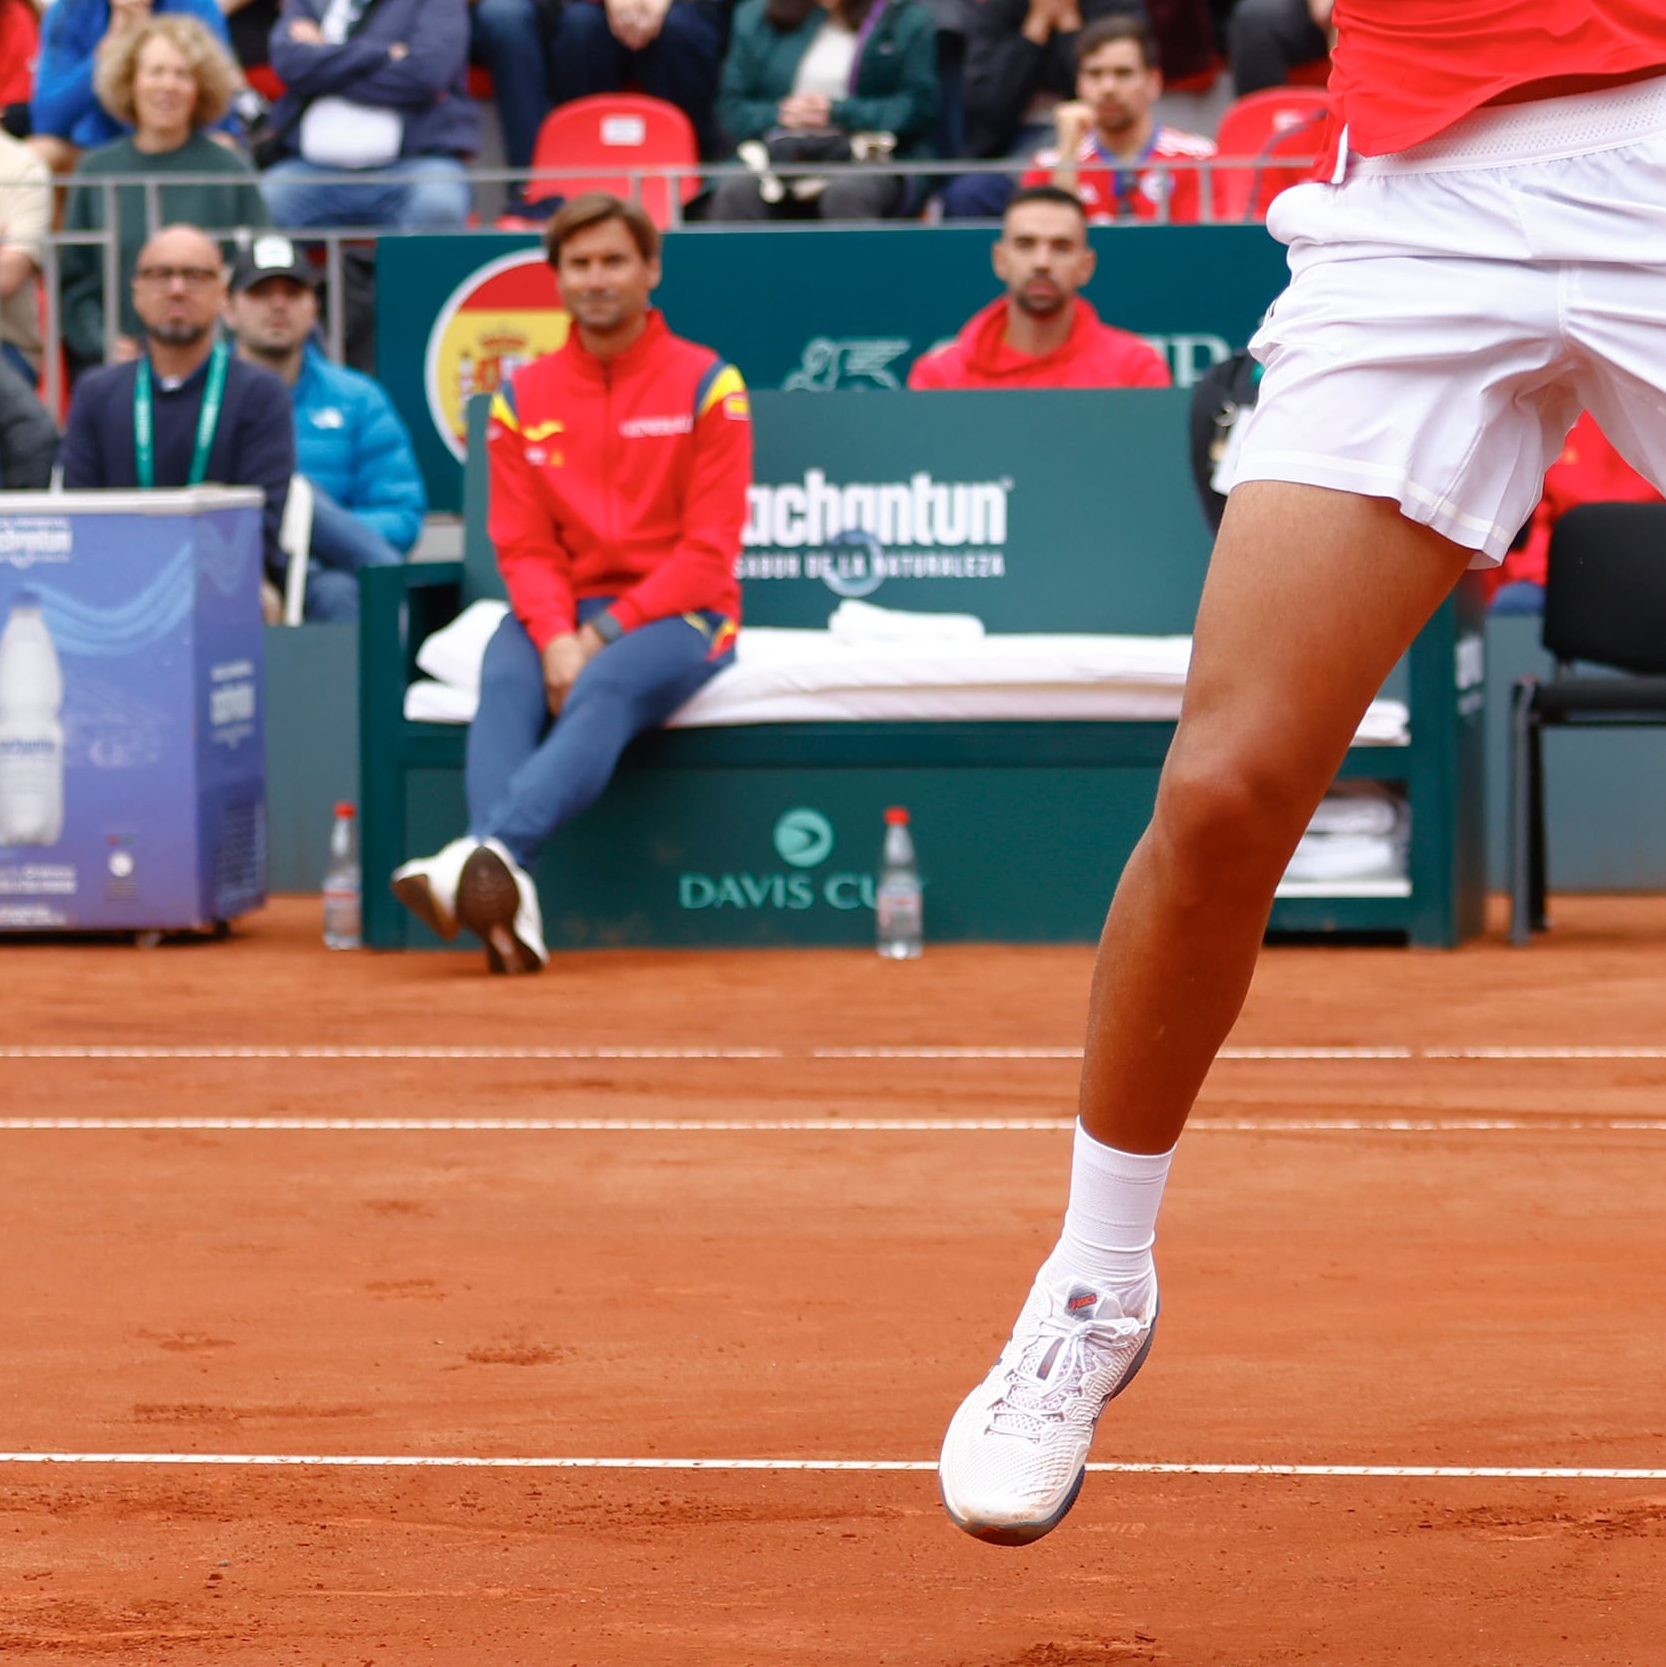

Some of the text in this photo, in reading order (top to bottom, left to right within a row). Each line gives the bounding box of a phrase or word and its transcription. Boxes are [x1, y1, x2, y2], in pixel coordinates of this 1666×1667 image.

[740, 467, 1008, 547] achantun
[679, 872, 879, 910] DAVIS CU
